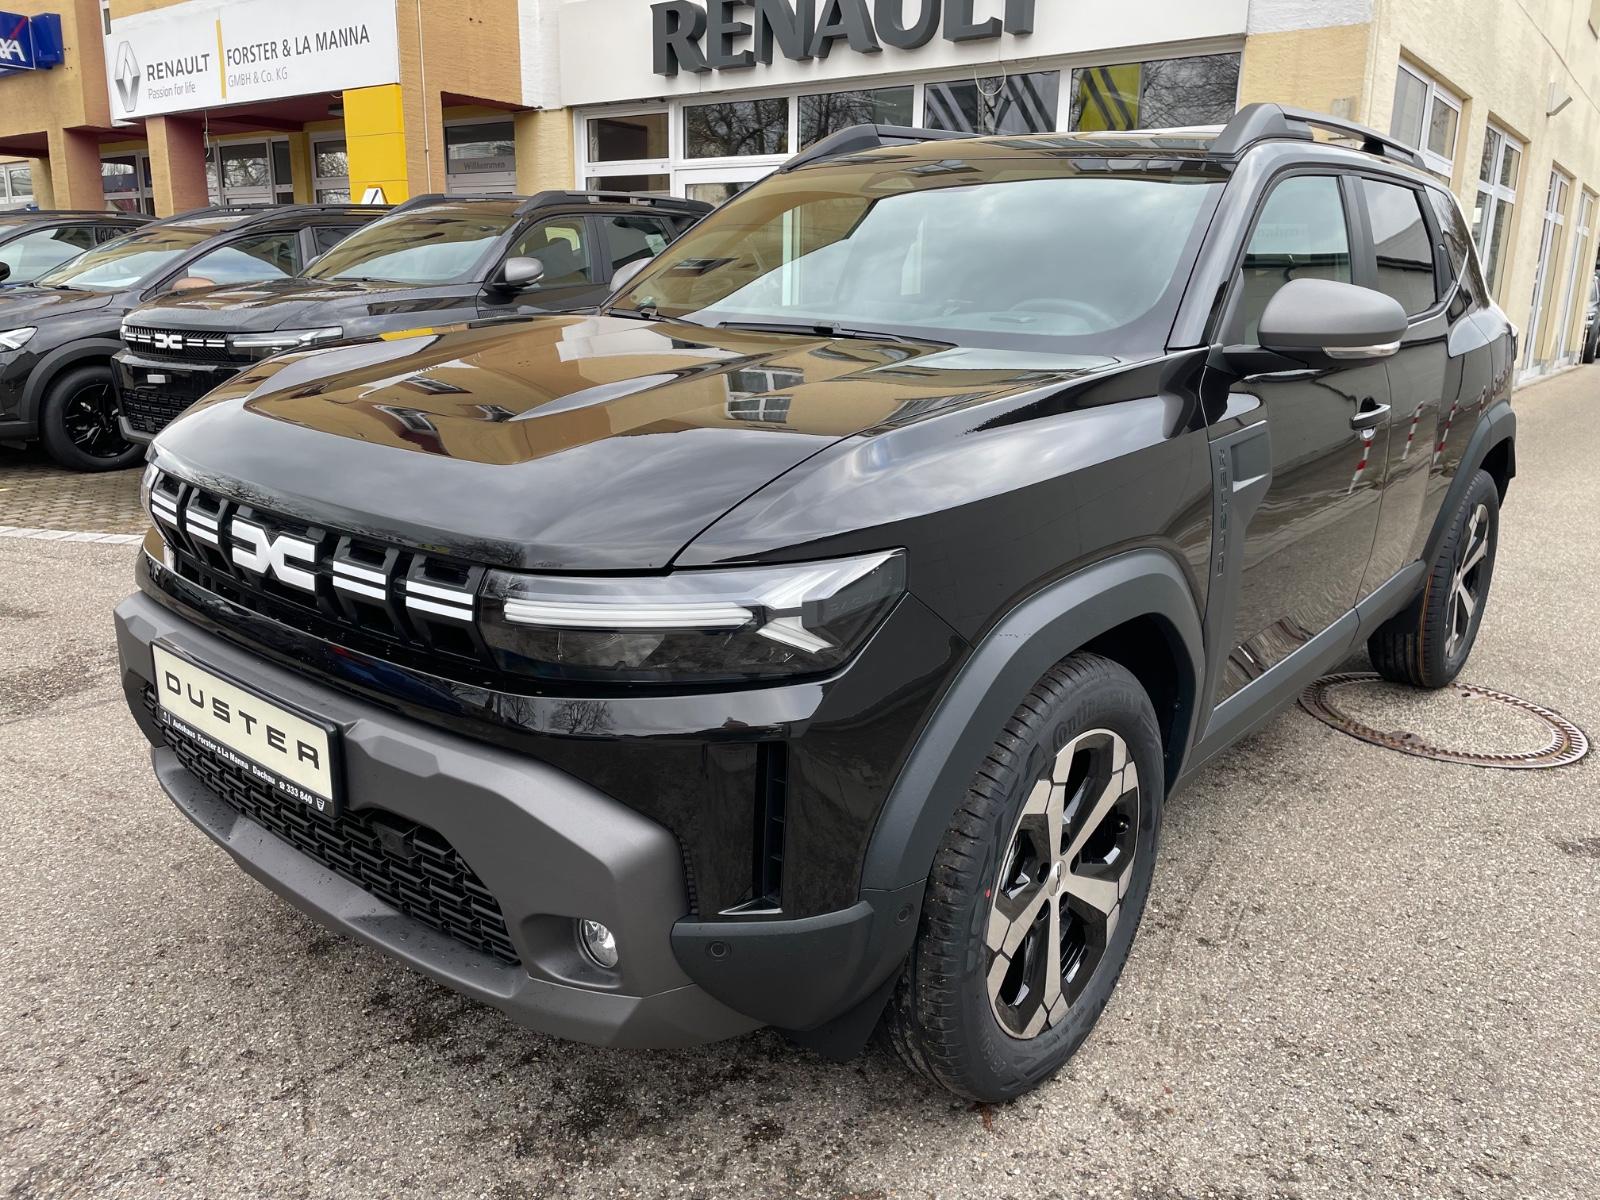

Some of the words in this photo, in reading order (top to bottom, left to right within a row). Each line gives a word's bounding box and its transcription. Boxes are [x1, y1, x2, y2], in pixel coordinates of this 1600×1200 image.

[0, 37, 26, 62] XA
[226, 41, 279, 67] FORSTER
[282, 38, 292, 57] &
[295, 35, 312, 56] LA
[315, 24, 371, 53] MANNA
[146, 53, 210, 81] RENAULT
[228, 72, 251, 88] GMBH
[253, 73, 260, 84] &
[261, 69, 274, 82] Co.
[276, 66, 288, 81] KG
[148, 86, 174, 99] Passion
[174, 82, 184, 96] for
[185, 80, 196, 94] life
[165, 670, 320, 771] DUSTER
[172, 719, 196, 739] Autohaus
[197, 733, 217, 751] Forster
[221, 748, 229, 759] La
[229, 751, 249, 770] Manna
[252, 765, 276, 785] Dachau
[286, 783, 299, 797] 333
[299, 790, 313, 805] 840
